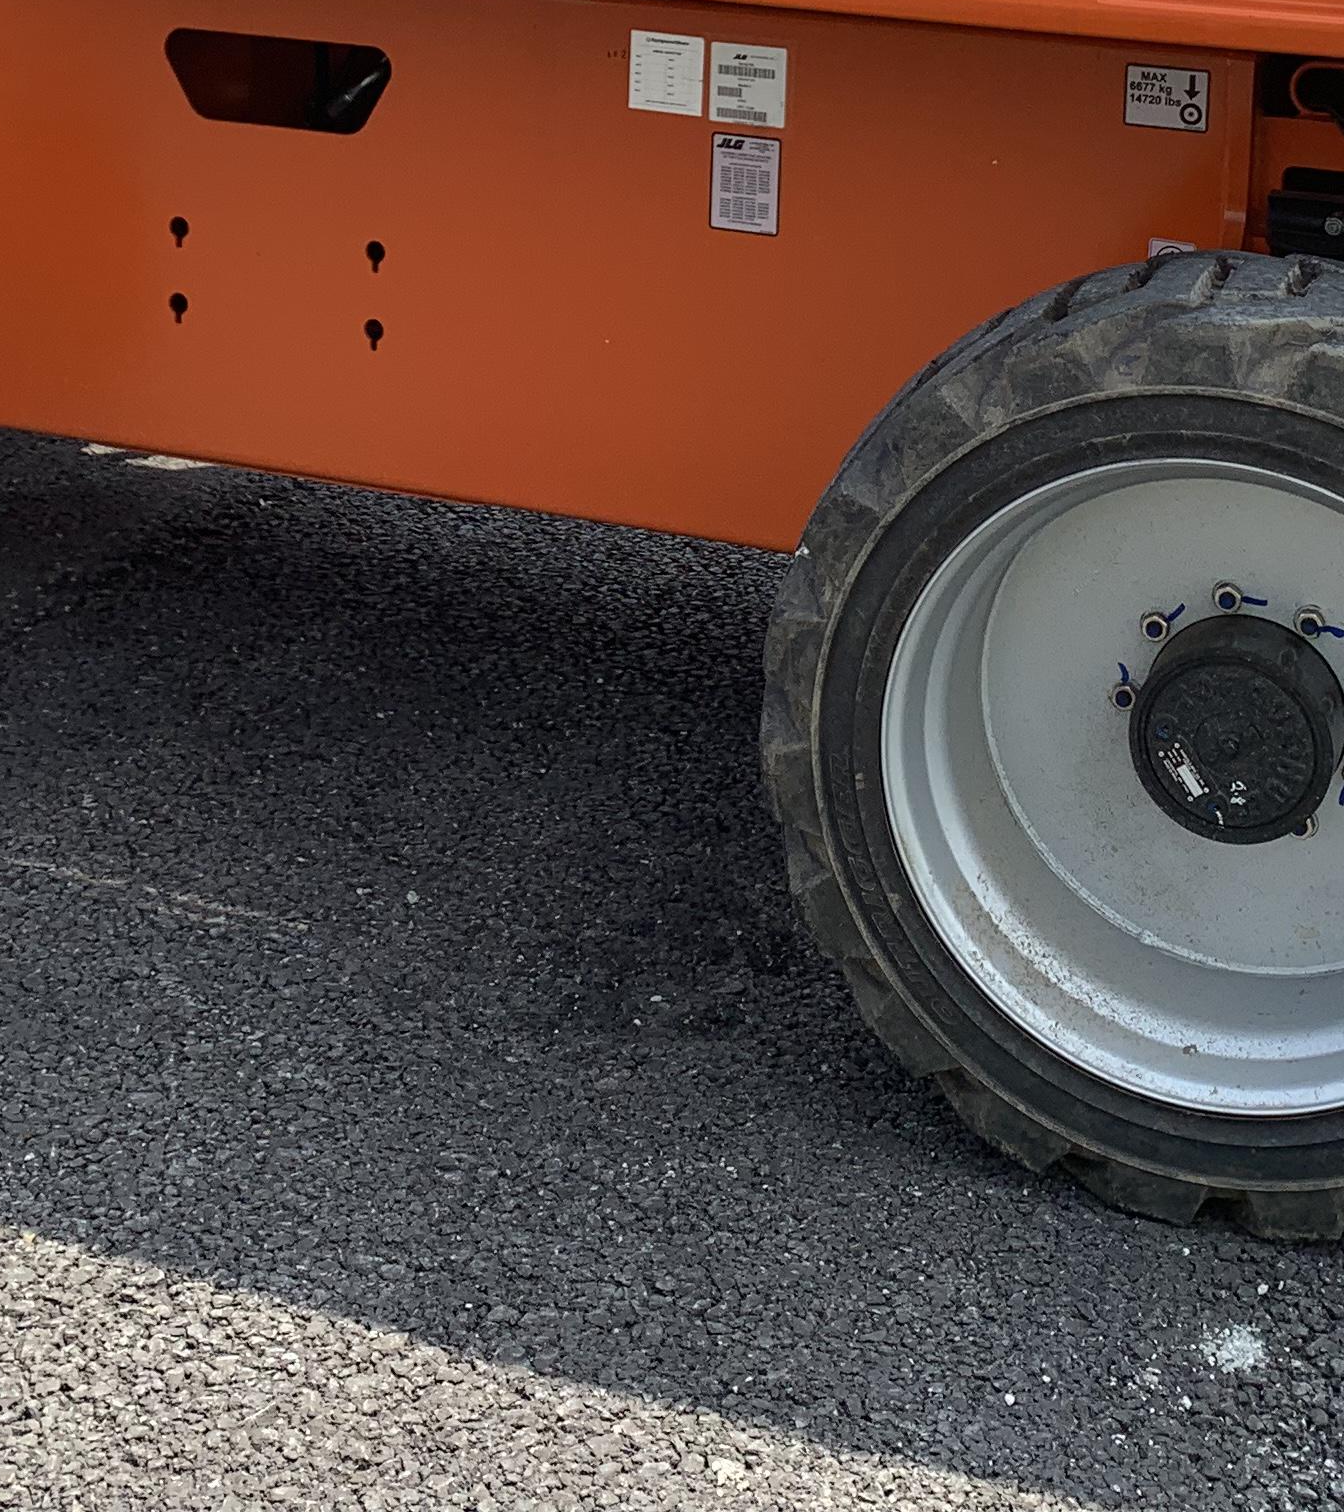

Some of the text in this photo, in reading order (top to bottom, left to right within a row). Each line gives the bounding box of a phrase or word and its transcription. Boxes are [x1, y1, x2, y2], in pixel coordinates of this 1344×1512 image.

[1141, 71, 1168, 83] MAX
[1130, 81, 1173, 96] 6677 kg
[1130, 93, 1182, 107] 14720 lbs
[716, 138, 746, 150] JLG
